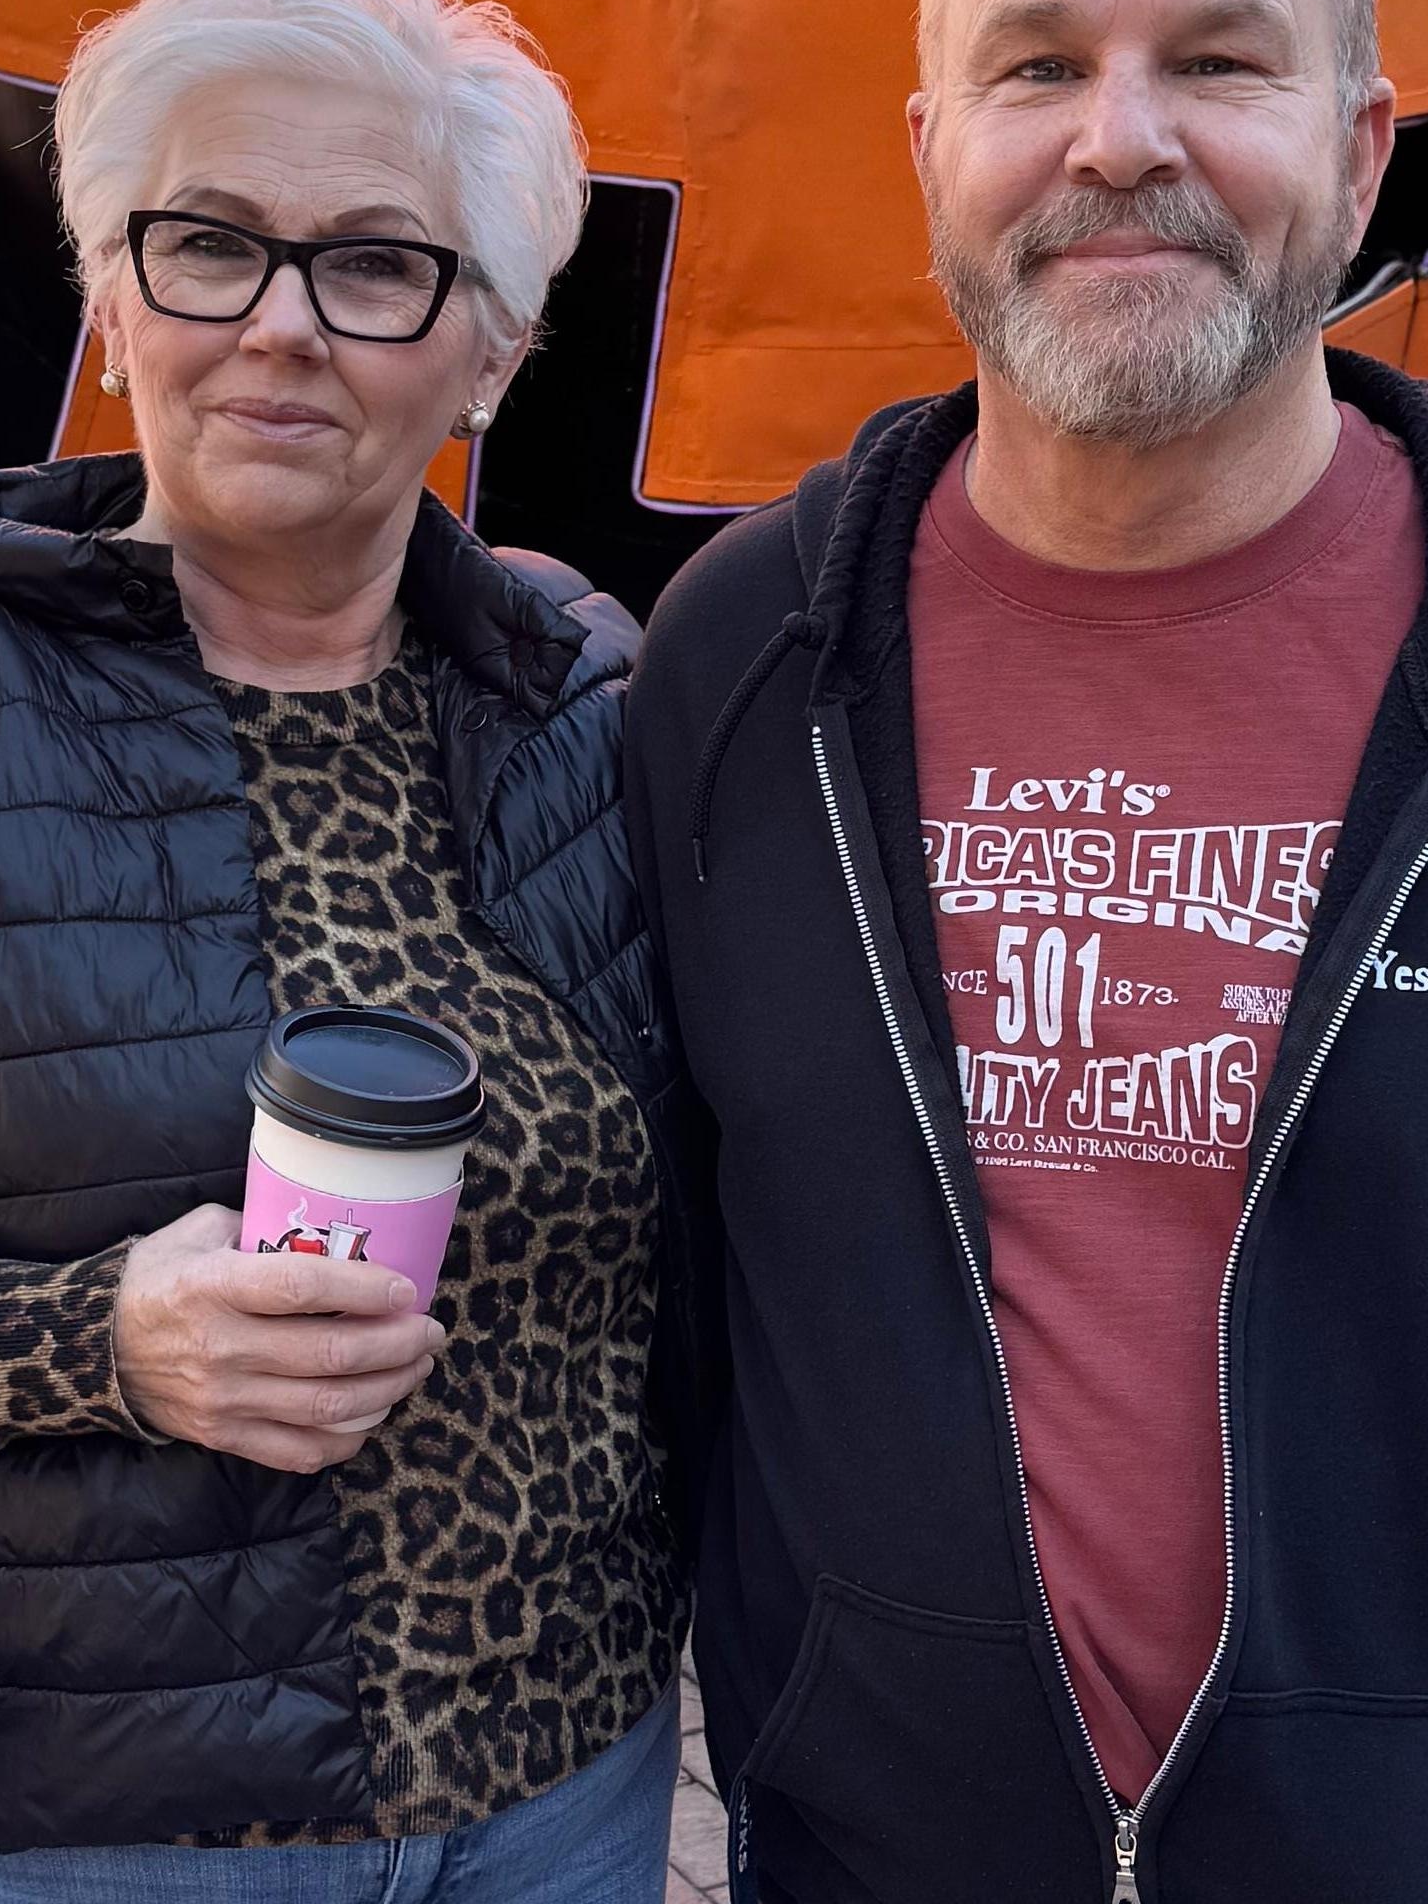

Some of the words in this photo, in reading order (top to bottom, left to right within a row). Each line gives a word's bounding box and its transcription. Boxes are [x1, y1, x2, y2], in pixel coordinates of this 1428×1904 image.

[995, 924, 1102, 1049] 501
[1099, 976, 1180, 1006] 1873.
[1066, 1033, 1257, 1149] JEANS
[993, 1131, 1029, 1152] CO.
[1033, 1134, 1073, 1155] SAN
[1076, 1137, 1188, 1166] FRANCISCO
[1191, 1148, 1236, 1171] CAL.
